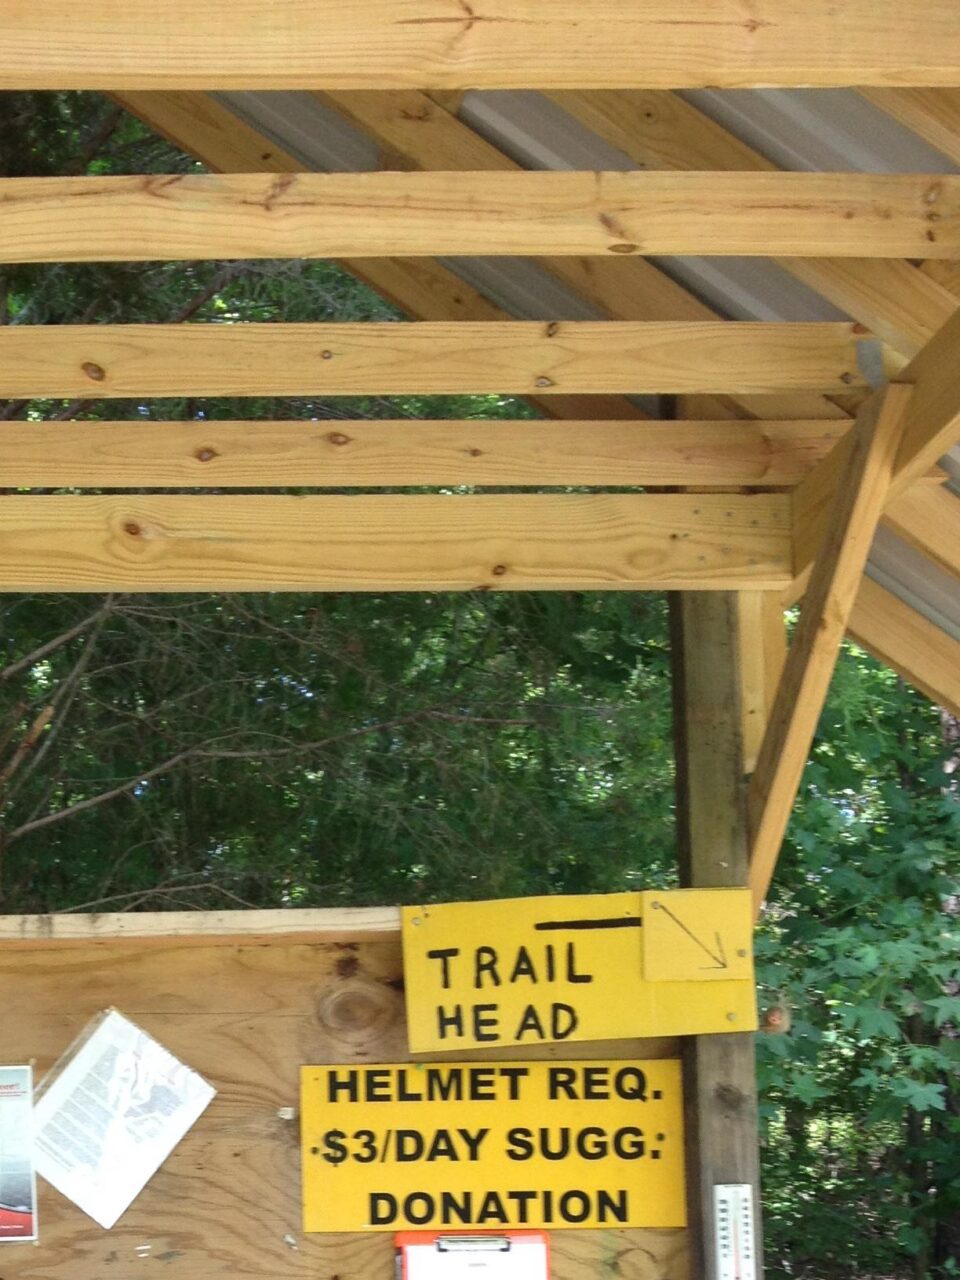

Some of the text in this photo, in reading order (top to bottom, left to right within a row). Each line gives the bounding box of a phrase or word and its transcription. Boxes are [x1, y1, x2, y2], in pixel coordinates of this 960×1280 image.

[427, 941, 593, 989] TRAIL
[437, 1002, 579, 1041] HEAD
[327, 1066, 663, 1103] HELMET REQ.
[322, 1126, 661, 1167] $3/DAY SUGG.
[368, 1189, 629, 1226] DONATION
